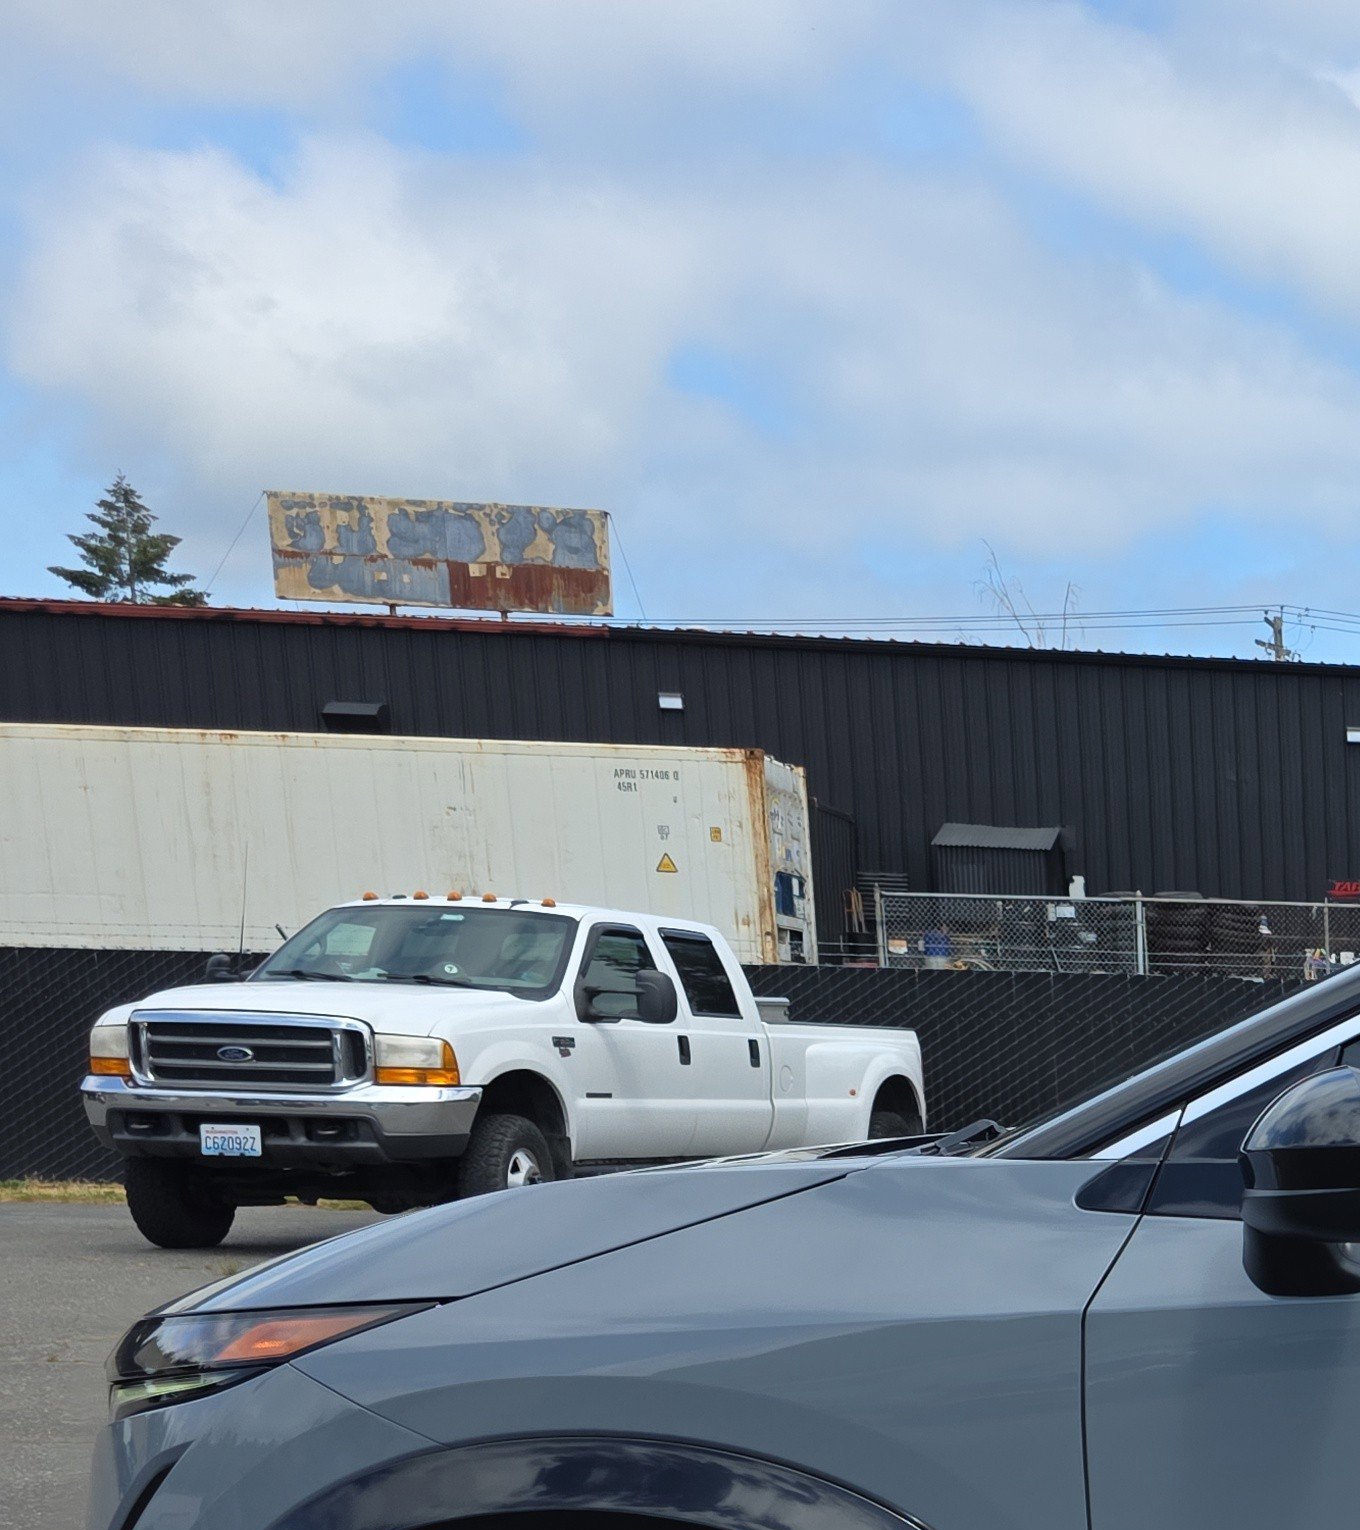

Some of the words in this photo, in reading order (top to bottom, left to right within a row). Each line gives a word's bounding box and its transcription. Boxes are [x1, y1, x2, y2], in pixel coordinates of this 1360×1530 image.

[614, 769, 636, 779] APRU
[617, 782, 637, 792] 45R1
[205, 1136, 257, 1151] C62092Z
